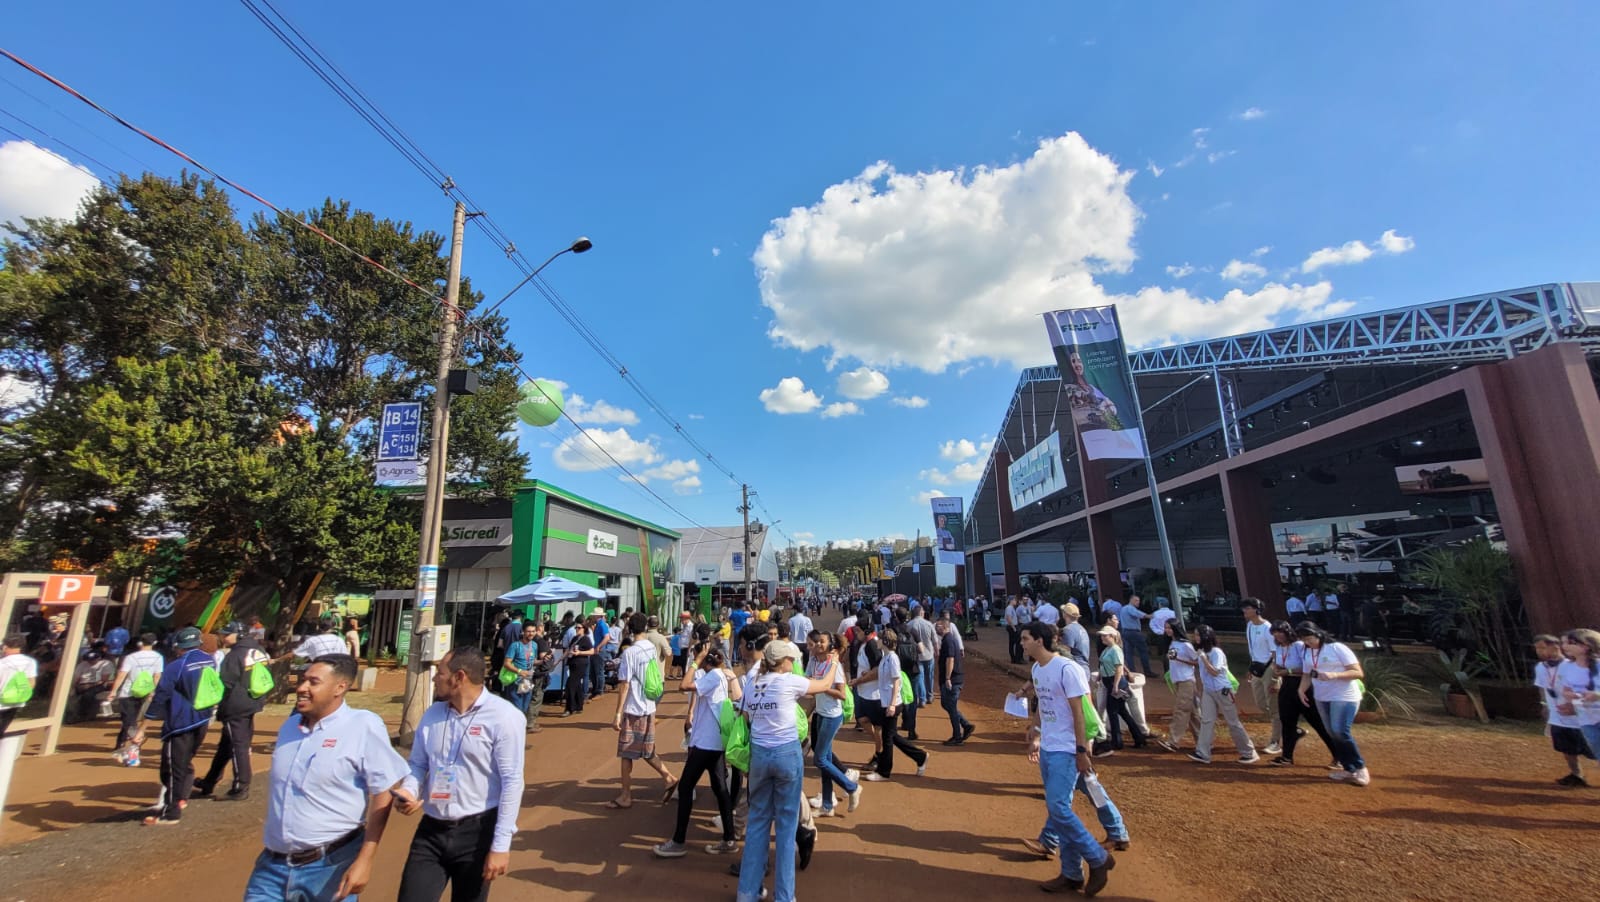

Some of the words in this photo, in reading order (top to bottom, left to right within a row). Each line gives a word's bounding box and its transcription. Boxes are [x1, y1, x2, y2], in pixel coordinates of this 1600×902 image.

[1060, 322, 1099, 332] FENDT
[391, 412, 401, 424] B
[403, 409, 418, 420] 14
[382, 441, 390, 450] A
[391, 438, 398, 447] C
[389, 467, 415, 477] Agres
[451, 526, 500, 540] Sicredi
[57, 578, 81, 599] P
